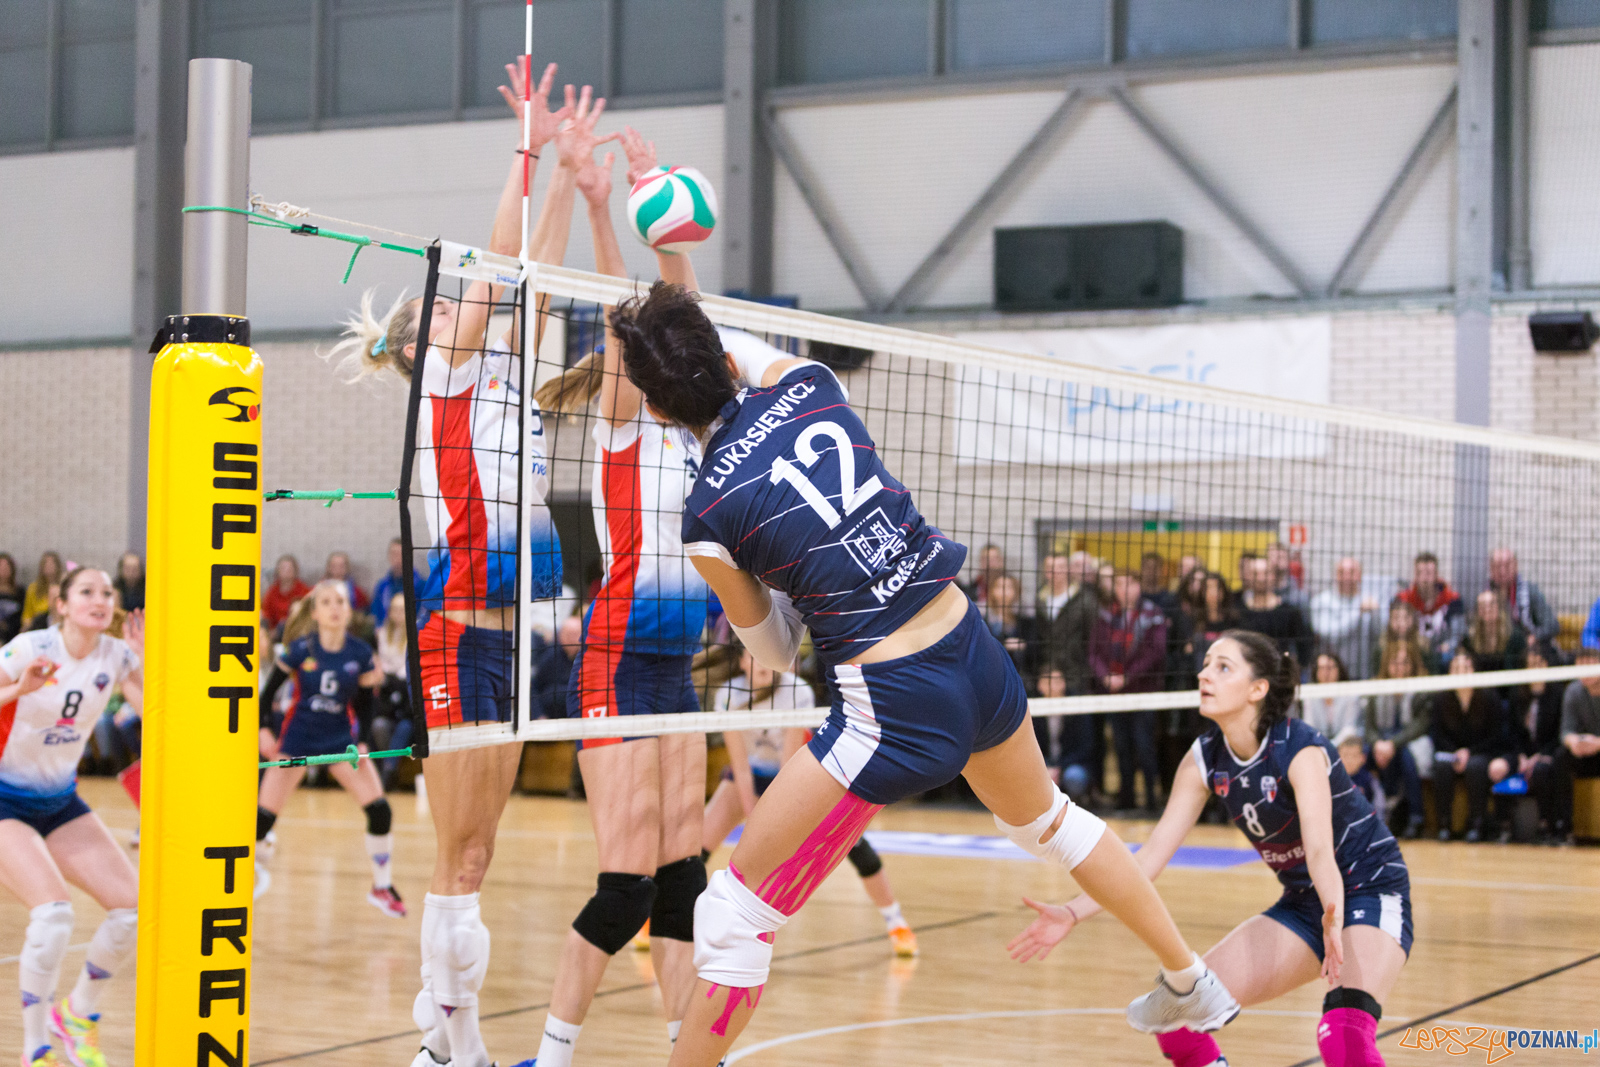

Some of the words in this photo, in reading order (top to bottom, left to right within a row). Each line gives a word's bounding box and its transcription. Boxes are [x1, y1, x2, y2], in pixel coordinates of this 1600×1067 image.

[705, 381, 816, 490] ŁUKASIEWICZ
[769, 421, 885, 530] 12
[207, 442, 258, 734] SPORT
[320, 670, 338, 696] 6
[429, 684, 451, 710] 15
[62, 690, 83, 719] 8
[1242, 802, 1266, 837] 8
[1262, 846, 1306, 864] Energ
[197, 845, 249, 1067] TRAN
